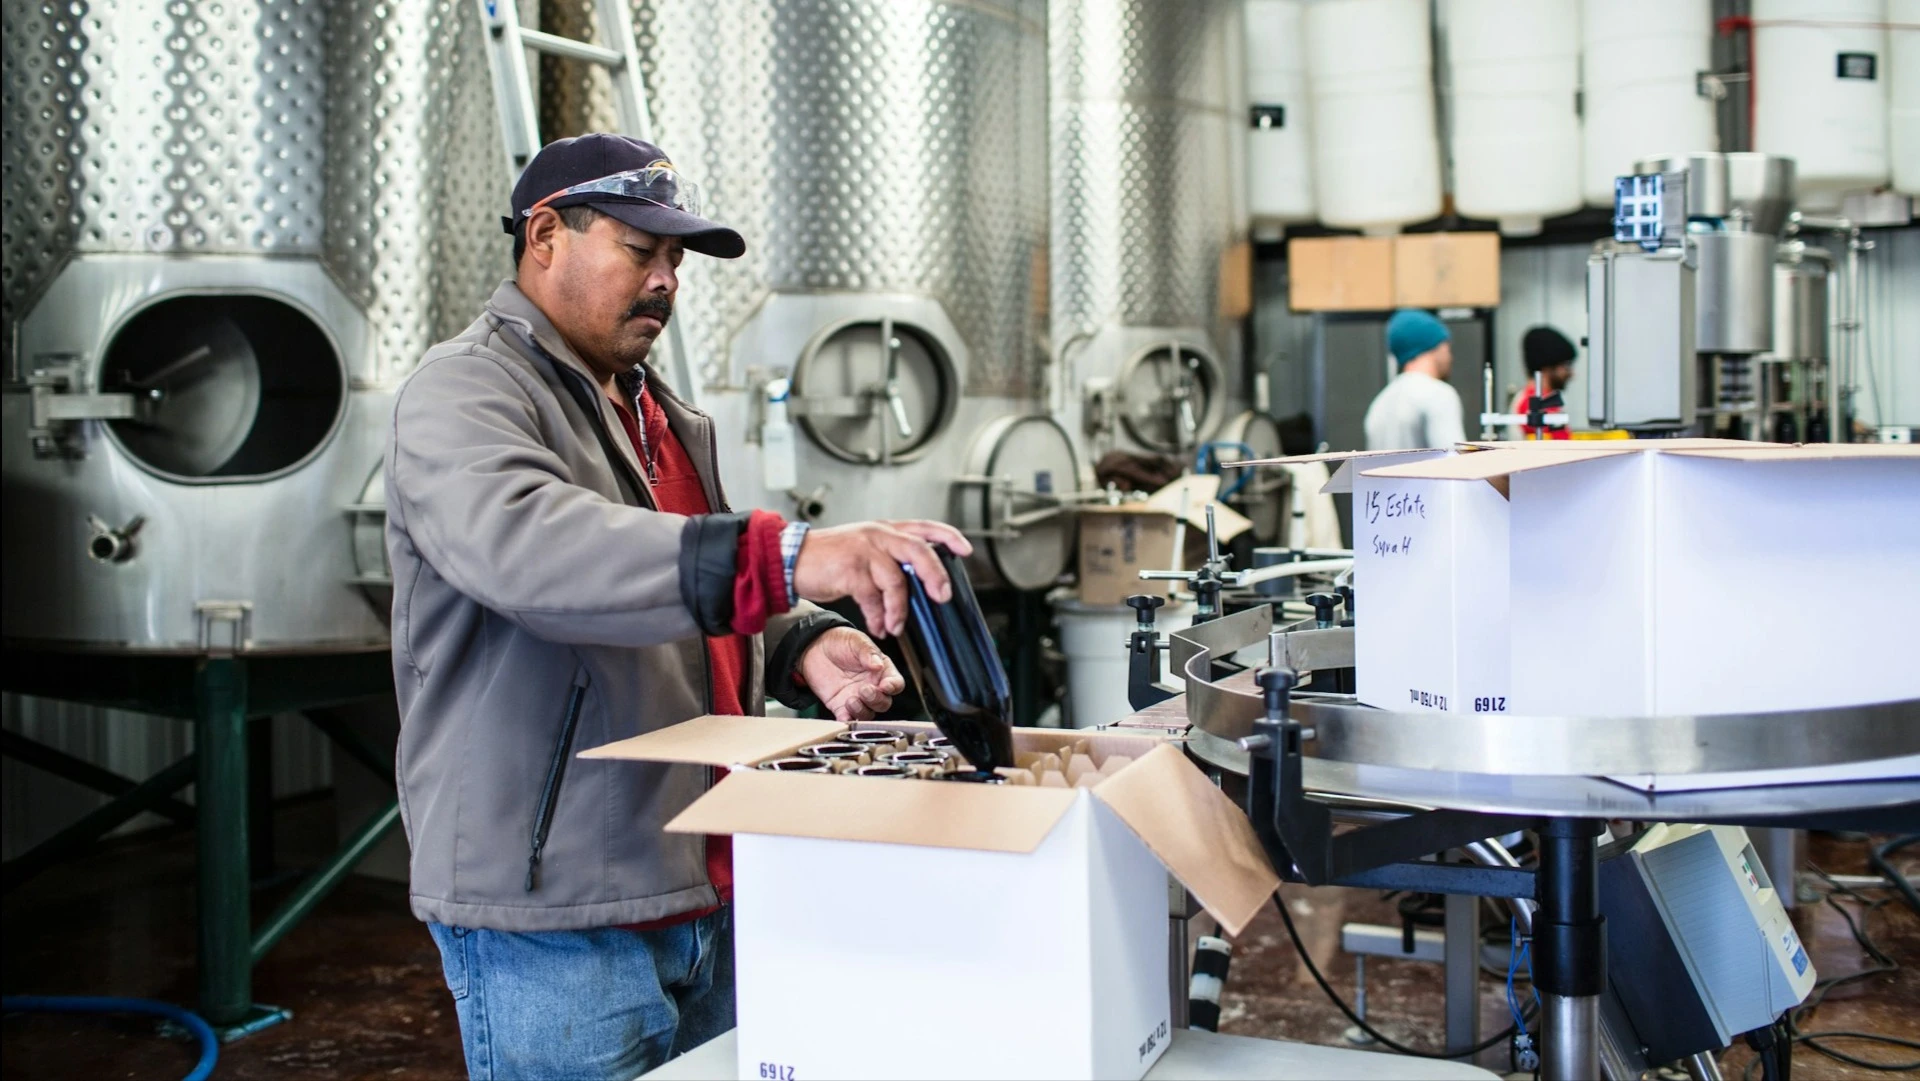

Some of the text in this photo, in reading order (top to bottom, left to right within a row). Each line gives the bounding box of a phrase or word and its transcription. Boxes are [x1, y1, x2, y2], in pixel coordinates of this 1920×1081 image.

[1365, 490, 1425, 524] 15 Estate
[1420, 691, 1433, 708] 750
[1439, 696, 1448, 712] 12
[1474, 697, 1506, 713] 2169
[1160, 1019, 1167, 1039] 12
[760, 1062, 795, 1081] 2169
